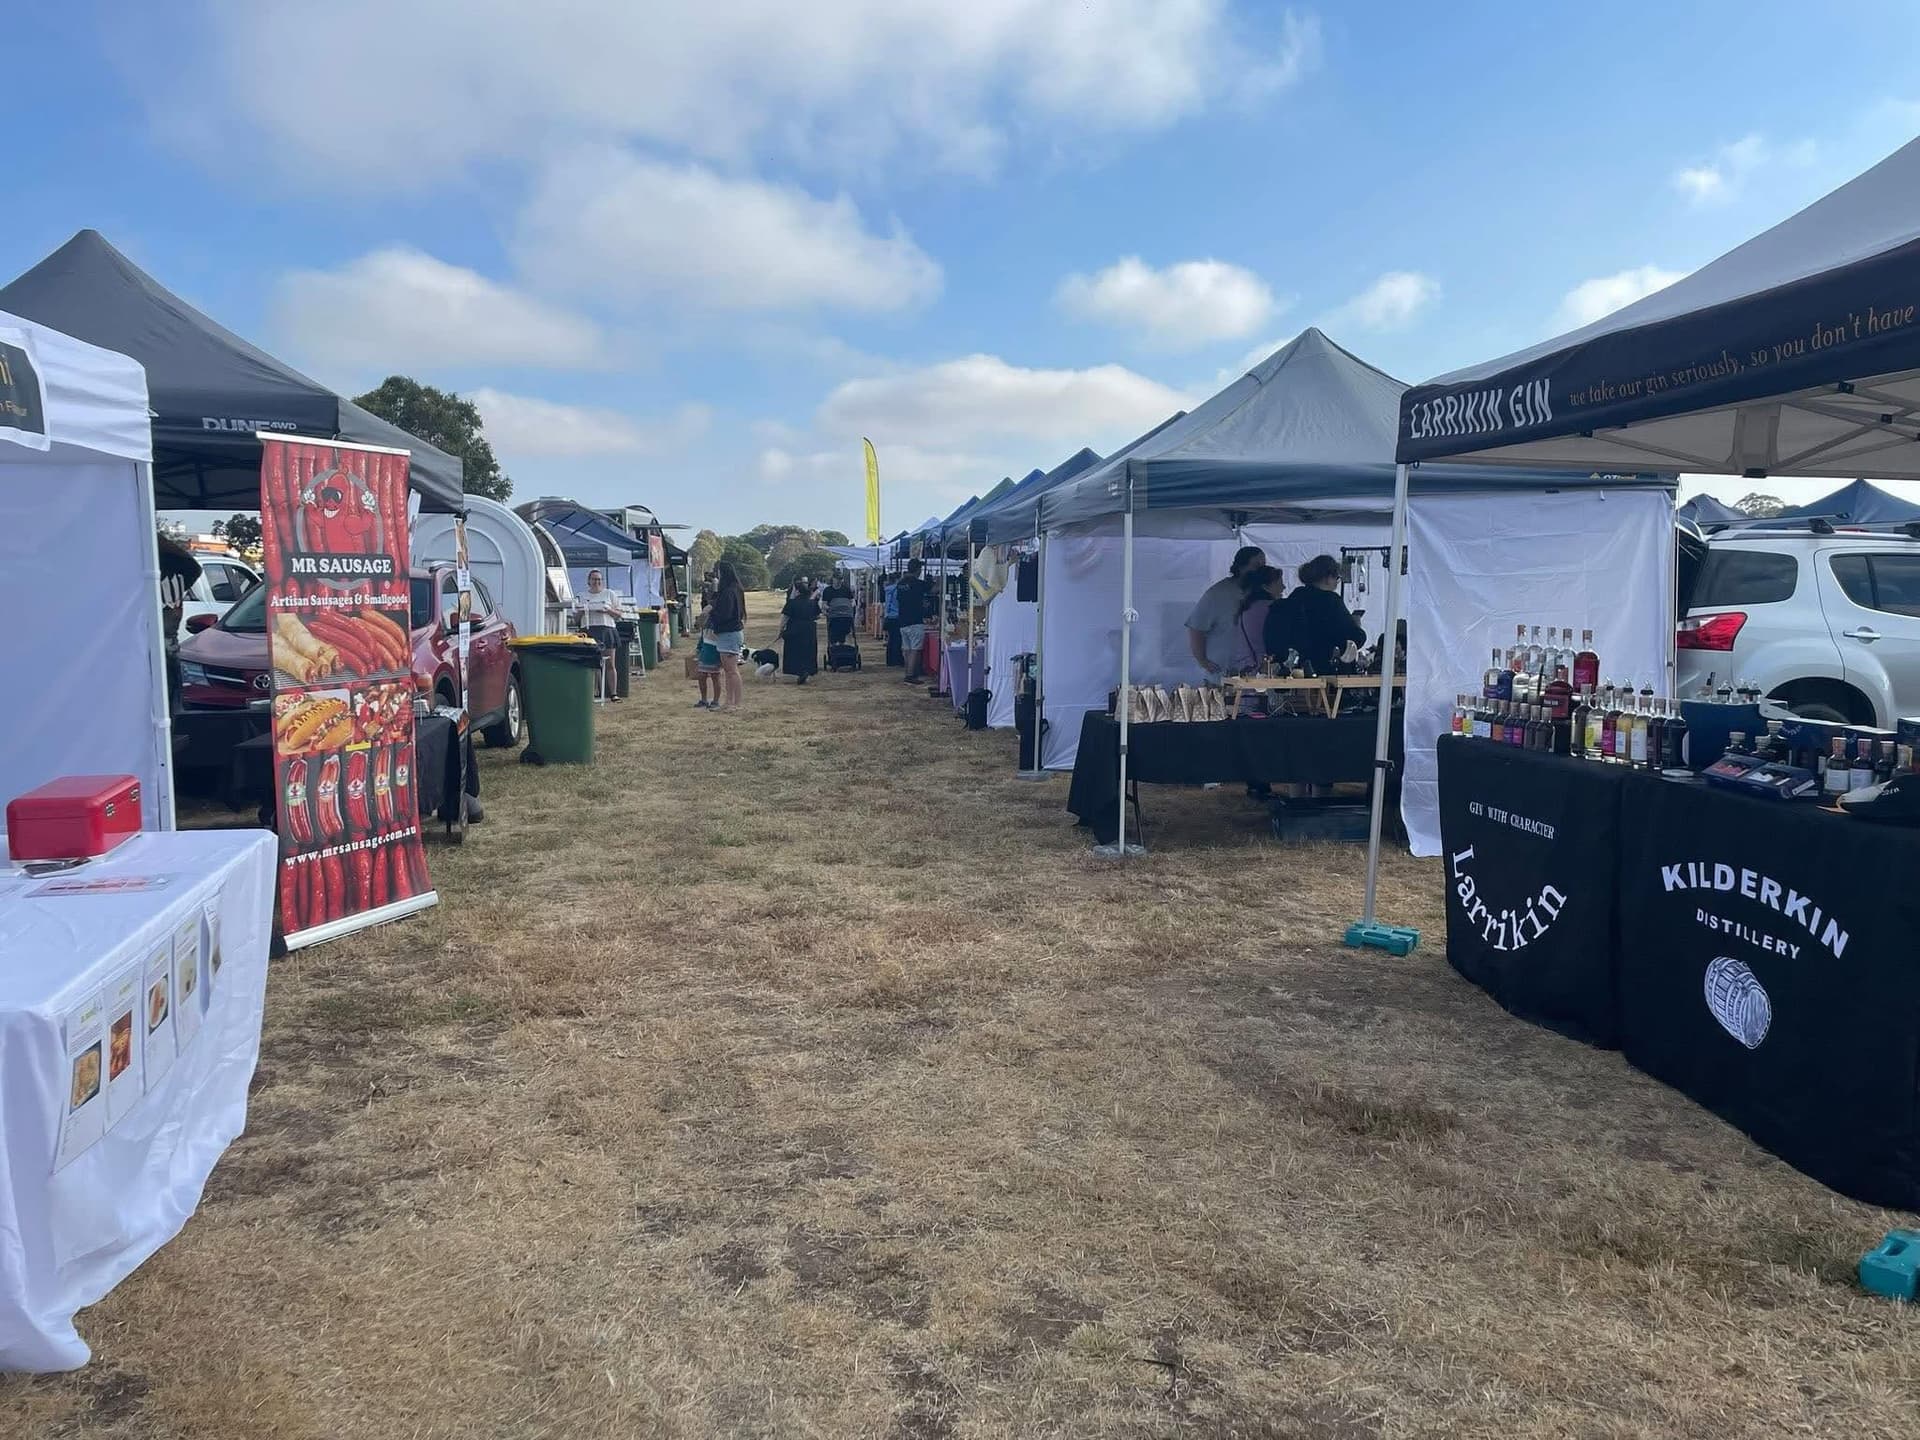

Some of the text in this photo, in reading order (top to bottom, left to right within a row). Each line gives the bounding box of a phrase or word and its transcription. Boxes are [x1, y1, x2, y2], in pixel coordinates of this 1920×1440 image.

[1569, 305, 1915, 406] we take our gin seriously, so you don't have
[1411, 378, 1553, 439] LARRIKIN GIN
[291, 557, 392, 574] MR SAUSAGE
[270, 593, 408, 608] Artisan Sausages & Smallgoods
[285, 825, 417, 867] www.mrsausage.com.au
[1469, 800, 1555, 840] GIN WITH CHARACTER
[1452, 843, 1568, 951] Larrikin
[1661, 862, 1849, 959] KILDERKIN
[1696, 908, 1801, 960] DISTILLERY
